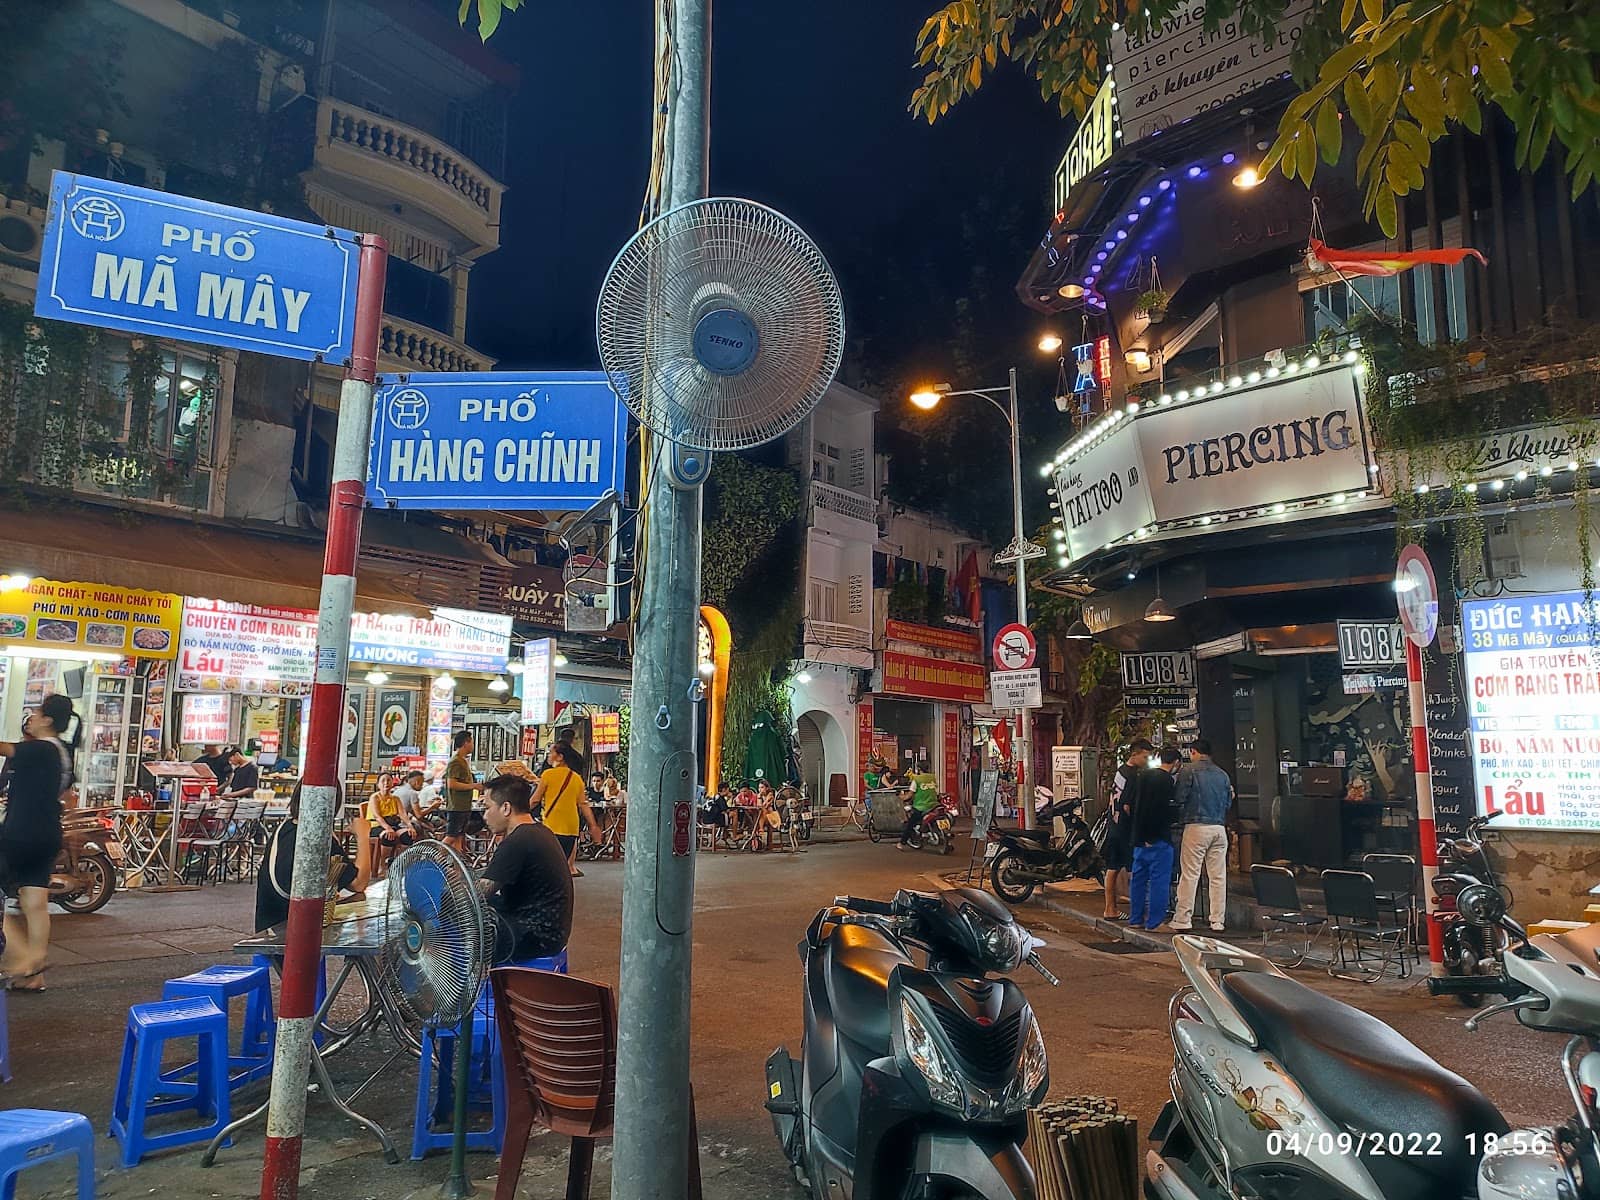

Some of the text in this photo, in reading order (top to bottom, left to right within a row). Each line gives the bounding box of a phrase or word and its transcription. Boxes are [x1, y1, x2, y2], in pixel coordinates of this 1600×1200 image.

[1129, 21, 1236, 82] piercing
[1164, 54, 1242, 96] khuyên
[162, 223, 260, 262] PHỐ
[91, 251, 312, 333] MÃ MÂY
[709, 334, 744, 349] SENKO
[459, 388, 541, 422] PHỐ
[388, 429, 601, 483] HÀNG CHĨNH
[1162, 411, 1353, 484] PIERCING
[1065, 471, 1123, 529] TATTOO
[93, 591, 123, 604] NGAN
[77, 604, 99, 618] XÀO
[105, 609, 129, 621] CƠM
[132, 613, 161, 624] RANG
[186, 613, 236, 631] CHUYÊN
[240, 619, 267, 635] CƠM
[271, 622, 302, 638] RANG
[1469, 602, 1523, 631] ĐỨC
[1344, 627, 1406, 660] 1984
[1471, 631, 1494, 648] 38
[1497, 633, 1519, 647] Mã
[1523, 630, 1554, 648] Mây
[182, 649, 225, 673] Lẩu
[1128, 655, 1190, 683] 1984
[1499, 657, 1524, 670] GIA
[1368, 676, 1377, 687] &
[1377, 675, 1408, 688] Piercing
[1474, 672, 1509, 698] CƠM
[1514, 673, 1559, 697] RANG
[1125, 695, 1189, 707] Tattoo & Piercing
[1431, 745, 1467, 758] Drinks
[1432, 784, 1460, 795] ogurt
[1484, 778, 1546, 816] Lẩu
